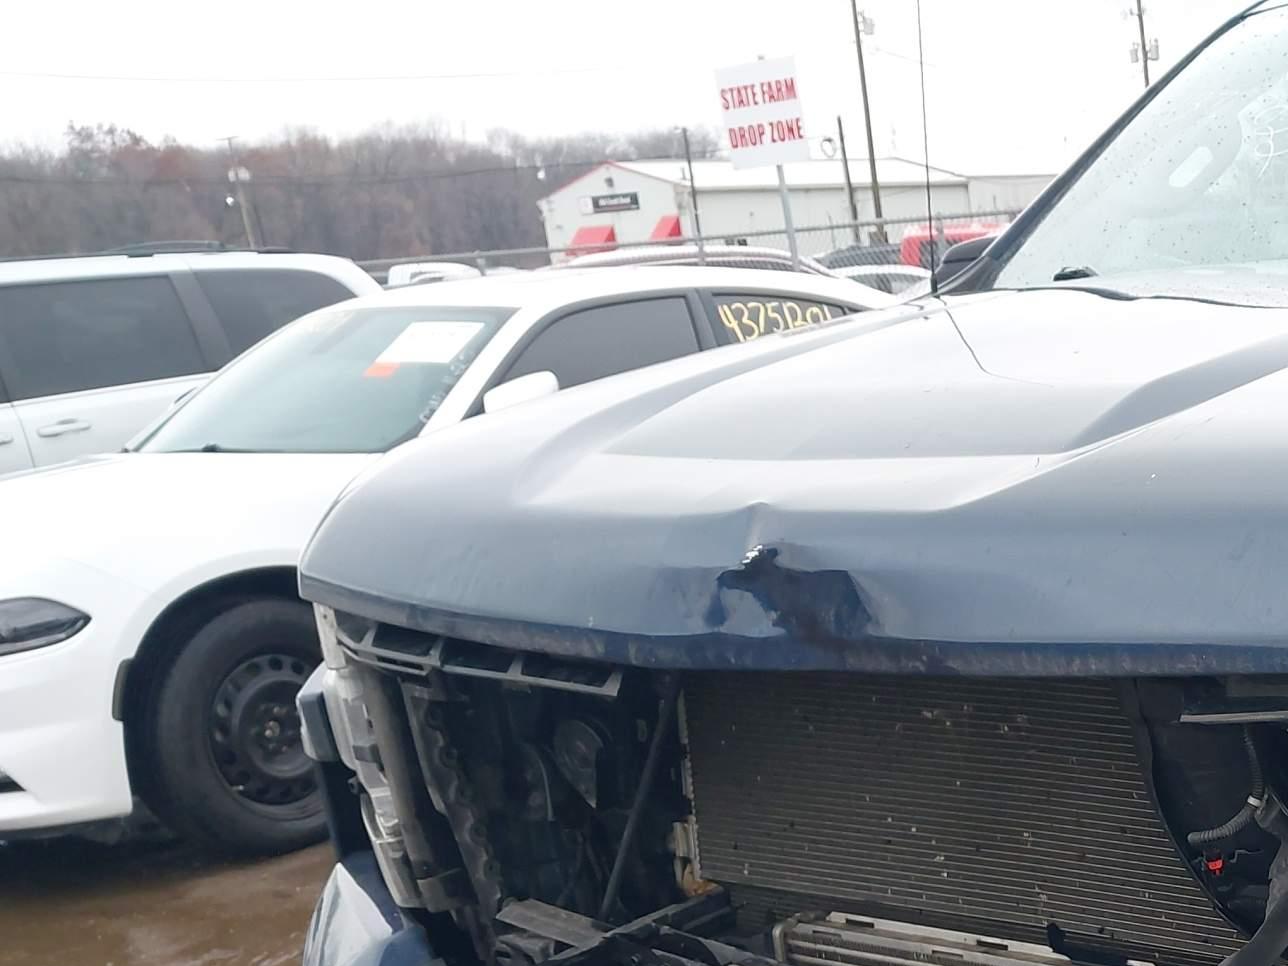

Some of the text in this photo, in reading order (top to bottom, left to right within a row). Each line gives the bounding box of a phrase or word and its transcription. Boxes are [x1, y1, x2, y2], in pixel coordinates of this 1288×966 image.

[720, 77, 798, 111] STATE FARM
[728, 117, 804, 150] DROP ZONE
